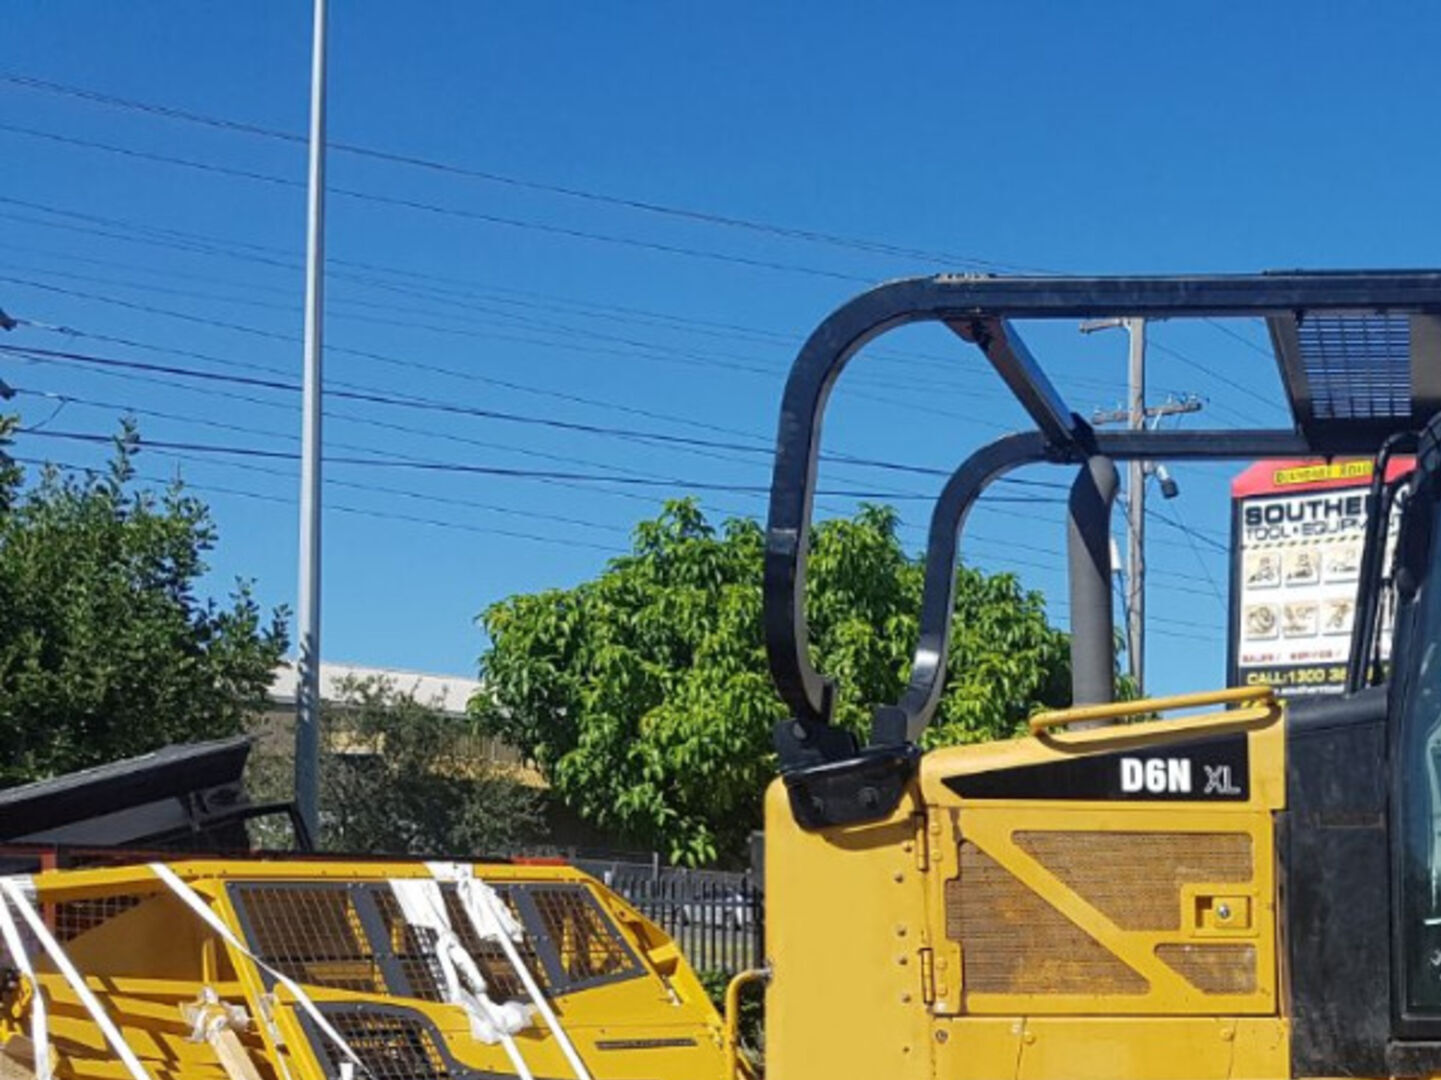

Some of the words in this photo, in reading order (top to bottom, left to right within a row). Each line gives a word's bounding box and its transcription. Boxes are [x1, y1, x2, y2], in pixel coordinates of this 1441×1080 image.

[1245, 496, 1365, 526] SOUTHE
[1121, 758, 1191, 793] D6N
[1203, 765, 1241, 794] XL
